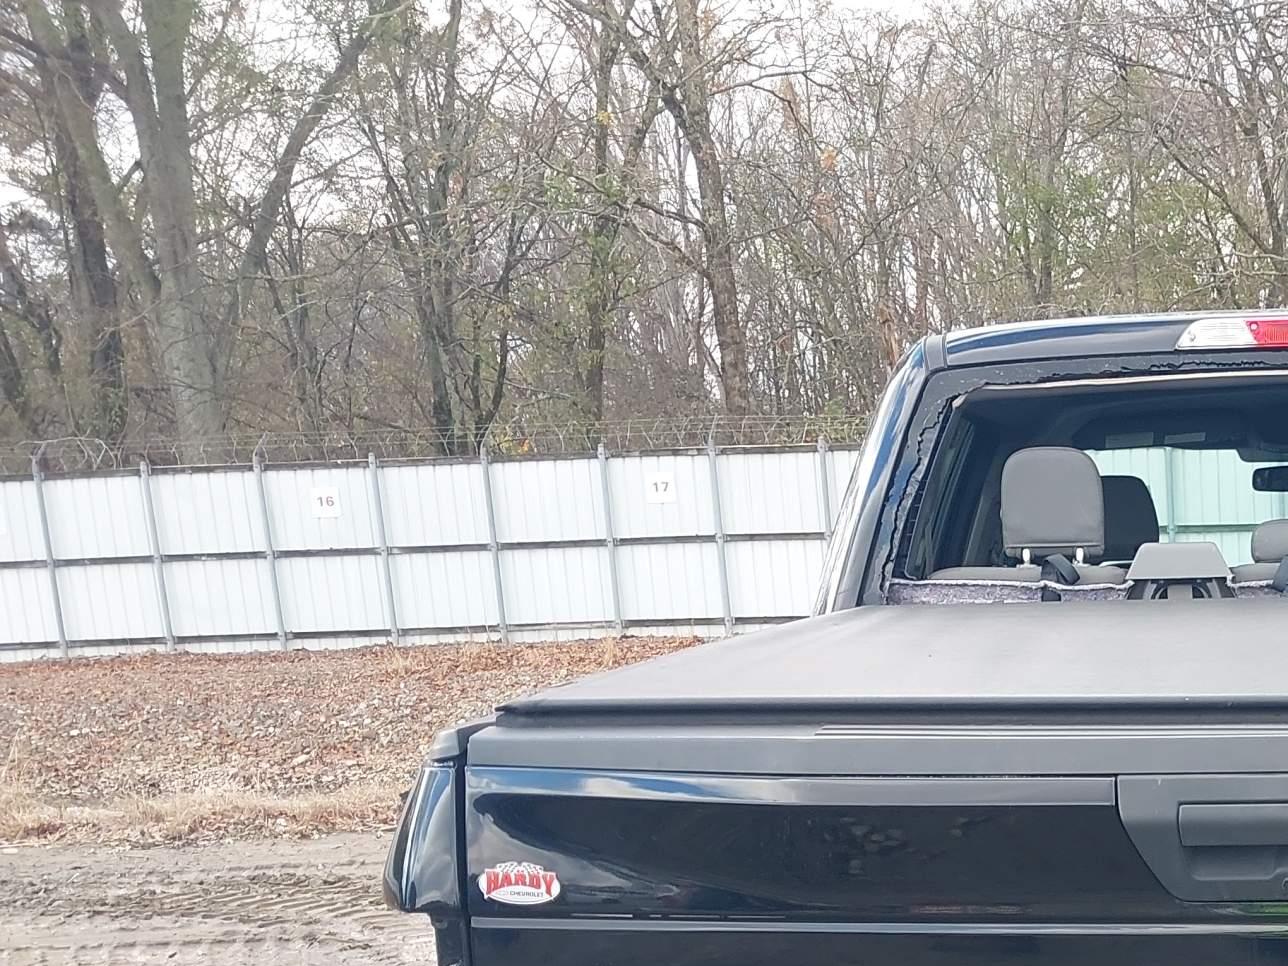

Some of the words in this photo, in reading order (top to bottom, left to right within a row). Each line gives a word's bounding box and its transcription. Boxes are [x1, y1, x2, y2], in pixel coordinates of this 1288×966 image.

[653, 481, 669, 493] 17
[317, 495, 335, 507] 16
[485, 869, 555, 898] HARDY
[509, 890, 544, 898] CHEVROLET
